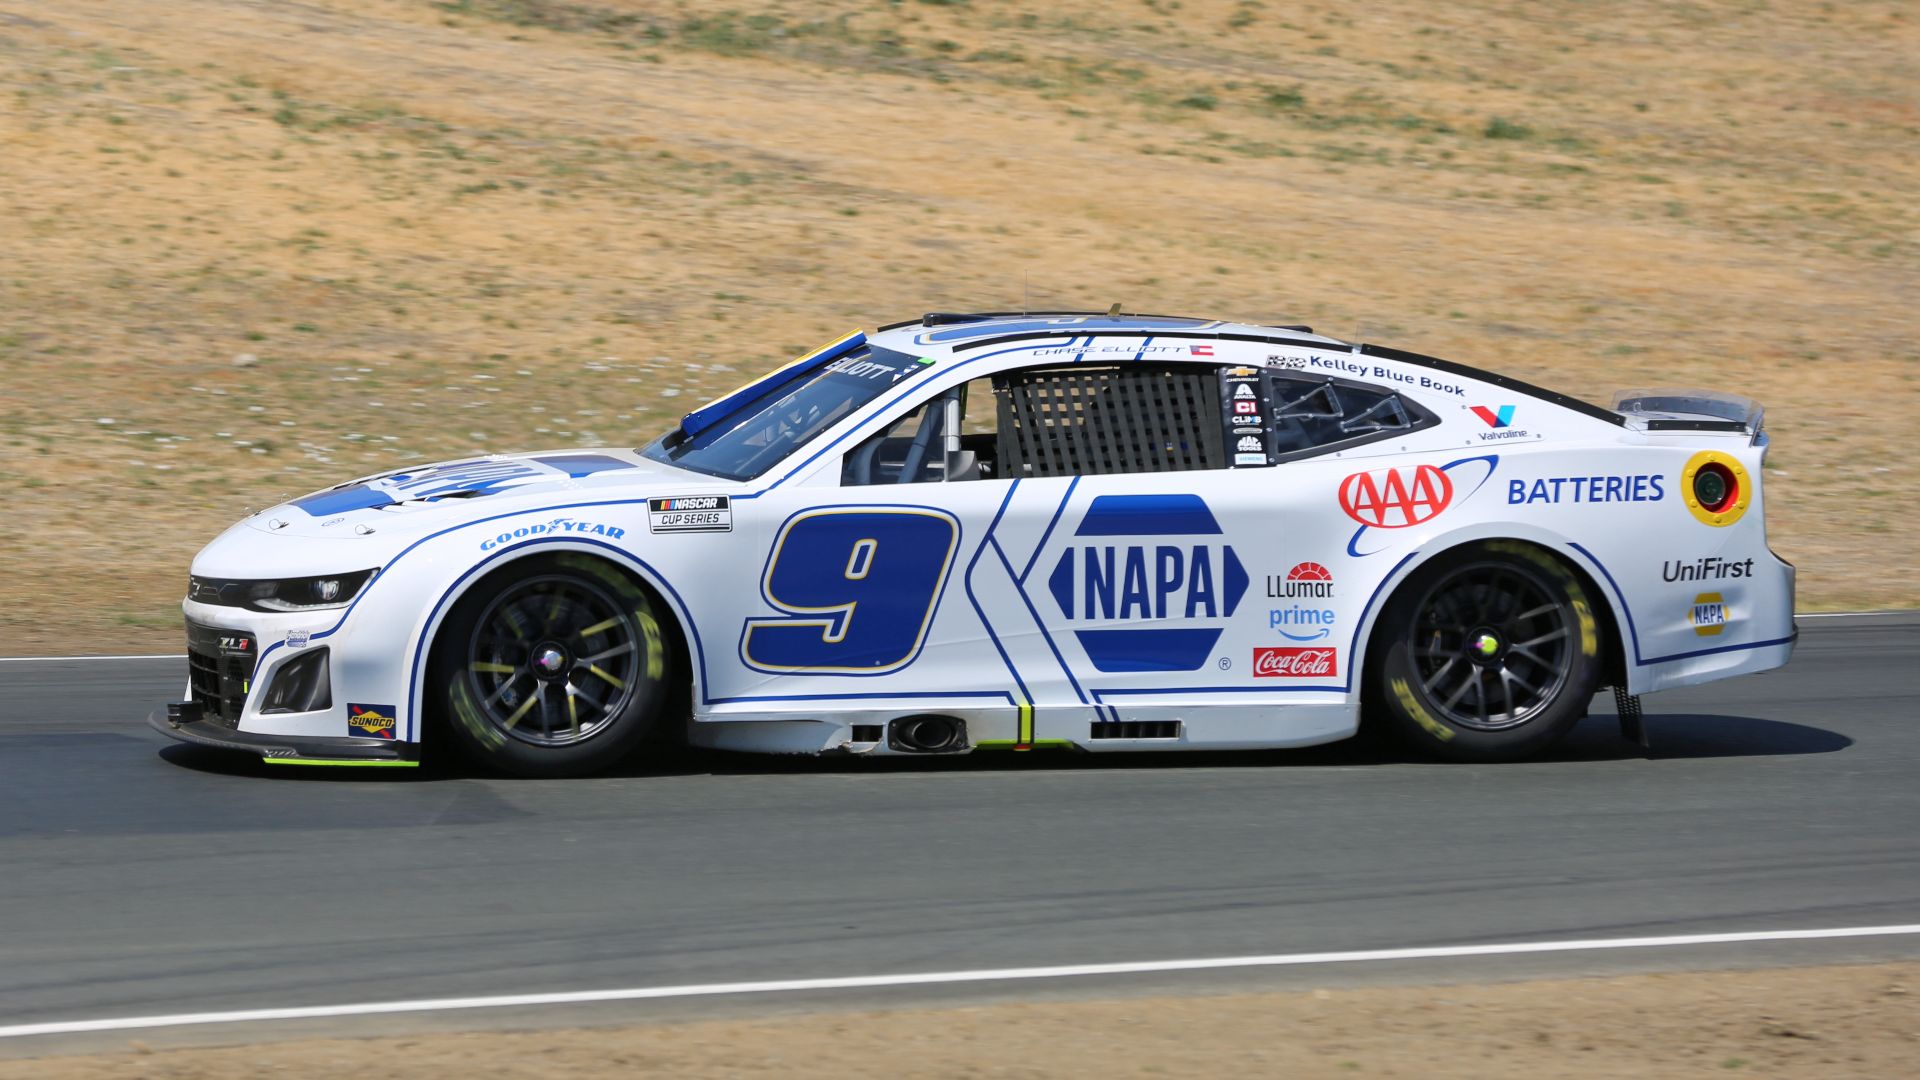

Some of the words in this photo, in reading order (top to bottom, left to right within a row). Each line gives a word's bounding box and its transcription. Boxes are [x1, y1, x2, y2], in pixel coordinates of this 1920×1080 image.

[1309, 355, 1368, 377] Kelley
[1374, 366, 1414, 384] Blue
[1420, 376, 1465, 397] Book
[1478, 430, 1528, 441] Valvoline
[1345, 465, 1449, 527] AAA
[1508, 474, 1664, 505] BATTERIES
[674, 498, 718, 510] NASCAR
[662, 514, 683, 525] CUP
[683, 513, 720, 524] SERIES
[480, 519, 625, 551] GOODYEAR
[1663, 557, 1754, 582] UniFirst
[740, 506, 960, 674] 9
[1085, 545, 1217, 620] NAPA
[1267, 575, 1334, 598] LLumar
[1270, 604, 1335, 628] prime
[1694, 603, 1724, 624] NAPA
[1256, 650, 1334, 675] Coca-Cola
[351, 716, 393, 728] SUNOCO
